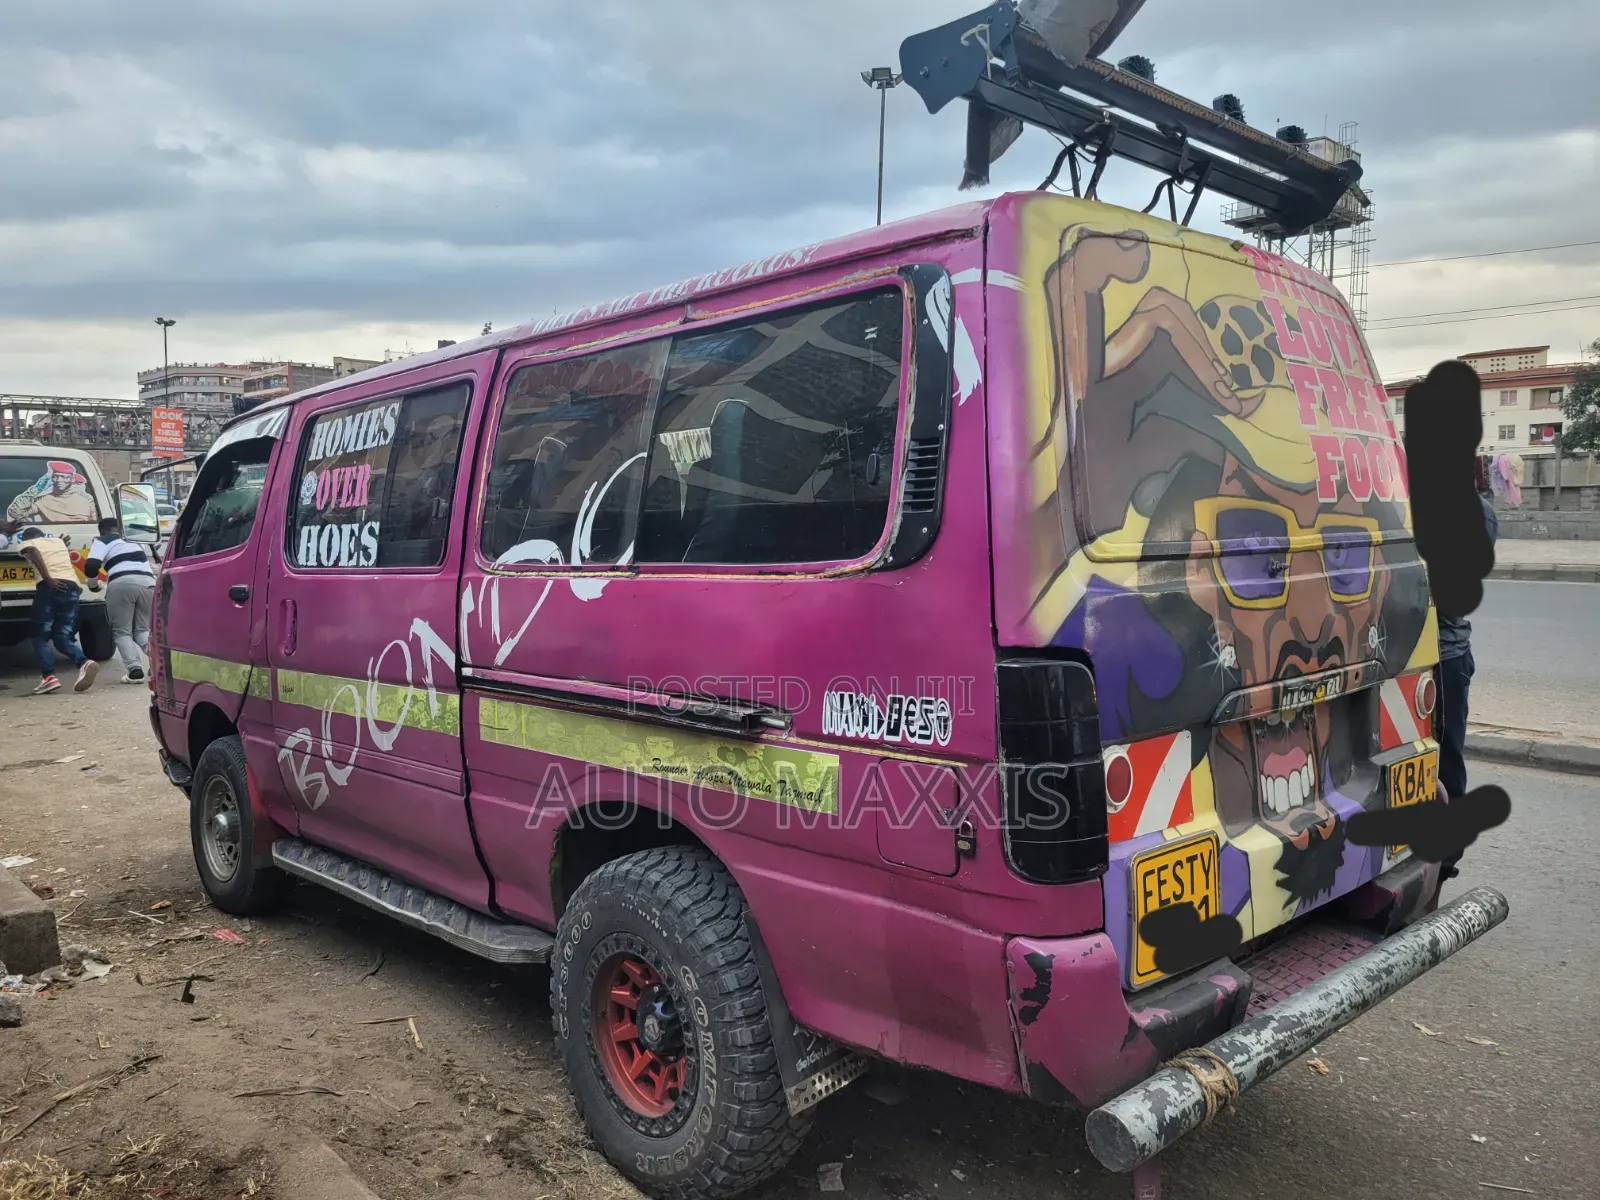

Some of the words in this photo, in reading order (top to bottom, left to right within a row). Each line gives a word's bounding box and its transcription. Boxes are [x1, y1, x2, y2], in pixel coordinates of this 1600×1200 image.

[153, 410, 183, 421] LOOK
[156, 428, 181, 437] THESE
[160, 421, 177, 429] GET
[308, 402, 400, 461] HOMIES
[315, 463, 371, 511] OVER
[298, 520, 380, 567] HOES
[0, 567, 17, 580] AG
[21, 567, 36, 580] 75
[651, 757, 688, 777] Rounder
[727, 770, 773, 794] Utawala
[1393, 758, 1425, 806] KBA
[1142, 849, 1212, 914] FESTY
